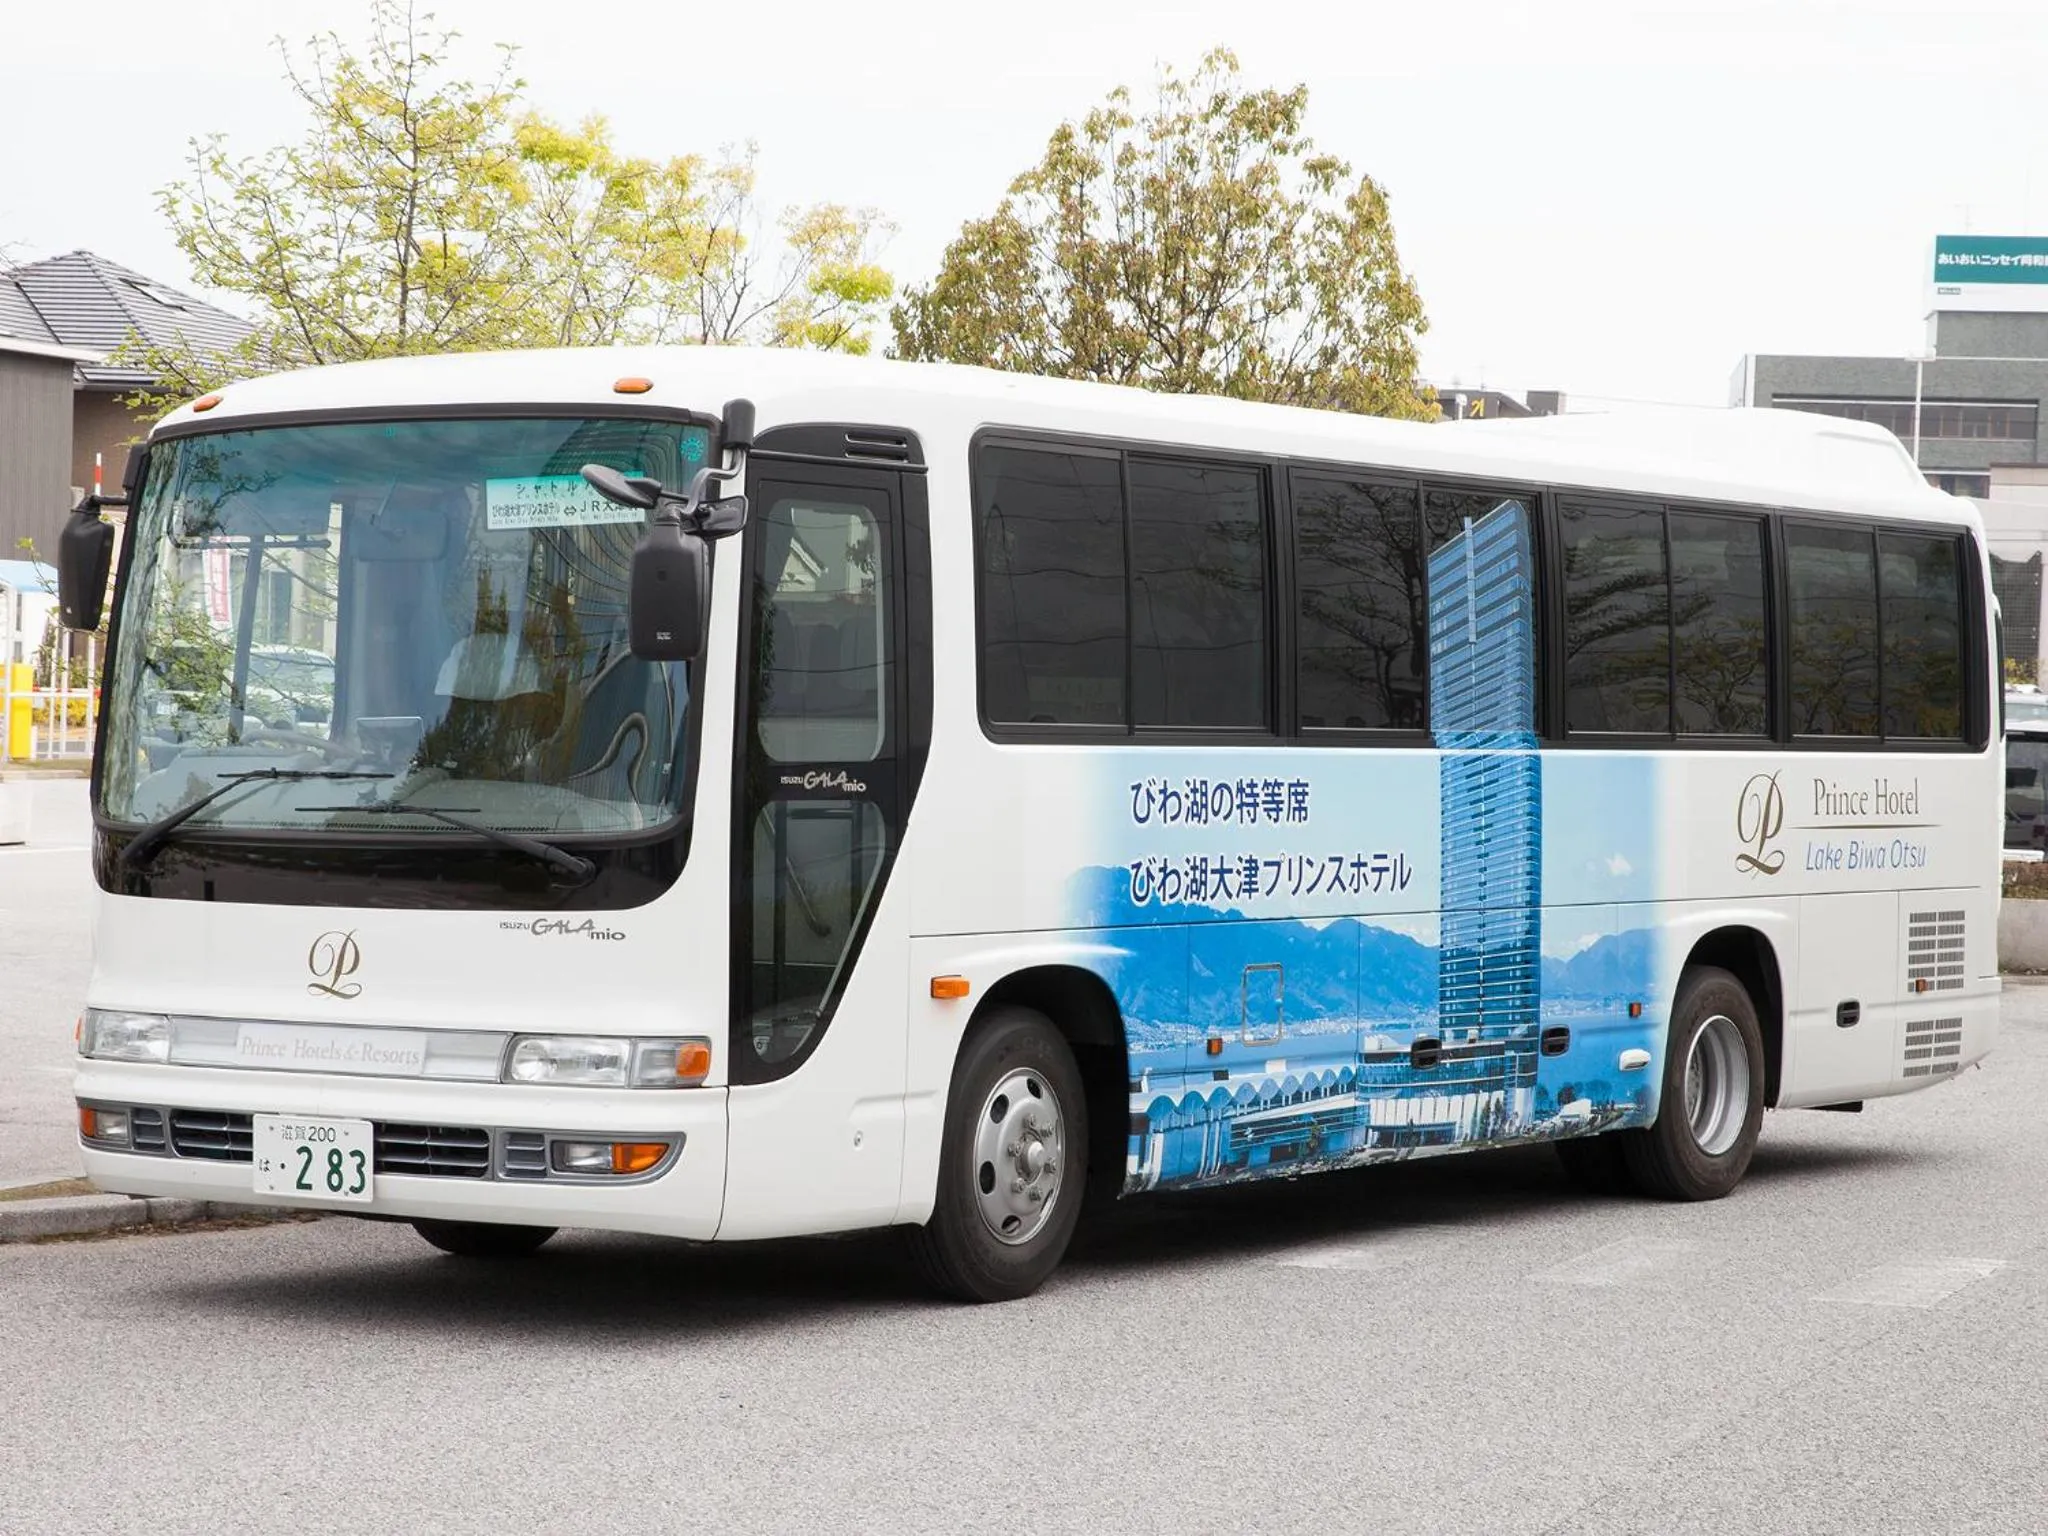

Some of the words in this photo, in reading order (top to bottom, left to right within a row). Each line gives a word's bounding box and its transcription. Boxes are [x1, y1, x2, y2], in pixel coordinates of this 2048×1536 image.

[1938, 252, 2048, 267] あいおいニッセイ同和
[803, 770, 848, 790] GALA
[842, 779, 867, 792] mio
[1813, 778, 1868, 816] Prince
[1875, 777, 1919, 815] Hotel
[1130, 778, 1309, 825] びわ湖の特等席
[1806, 841, 1846, 871] Lake
[1847, 840, 1887, 870] Biwa
[1890, 838, 1926, 869] Otsu
[1130, 852, 1412, 903] びわ湖大津プリンスホテル
[499, 922, 531, 930] ISUZU
[531, 918, 595, 937] GALA
[590, 928, 626, 941] mio
[241, 1036, 287, 1058] Prince
[293, 1038, 342, 1060] Hotels
[361, 1042, 421, 1065] Resorts
